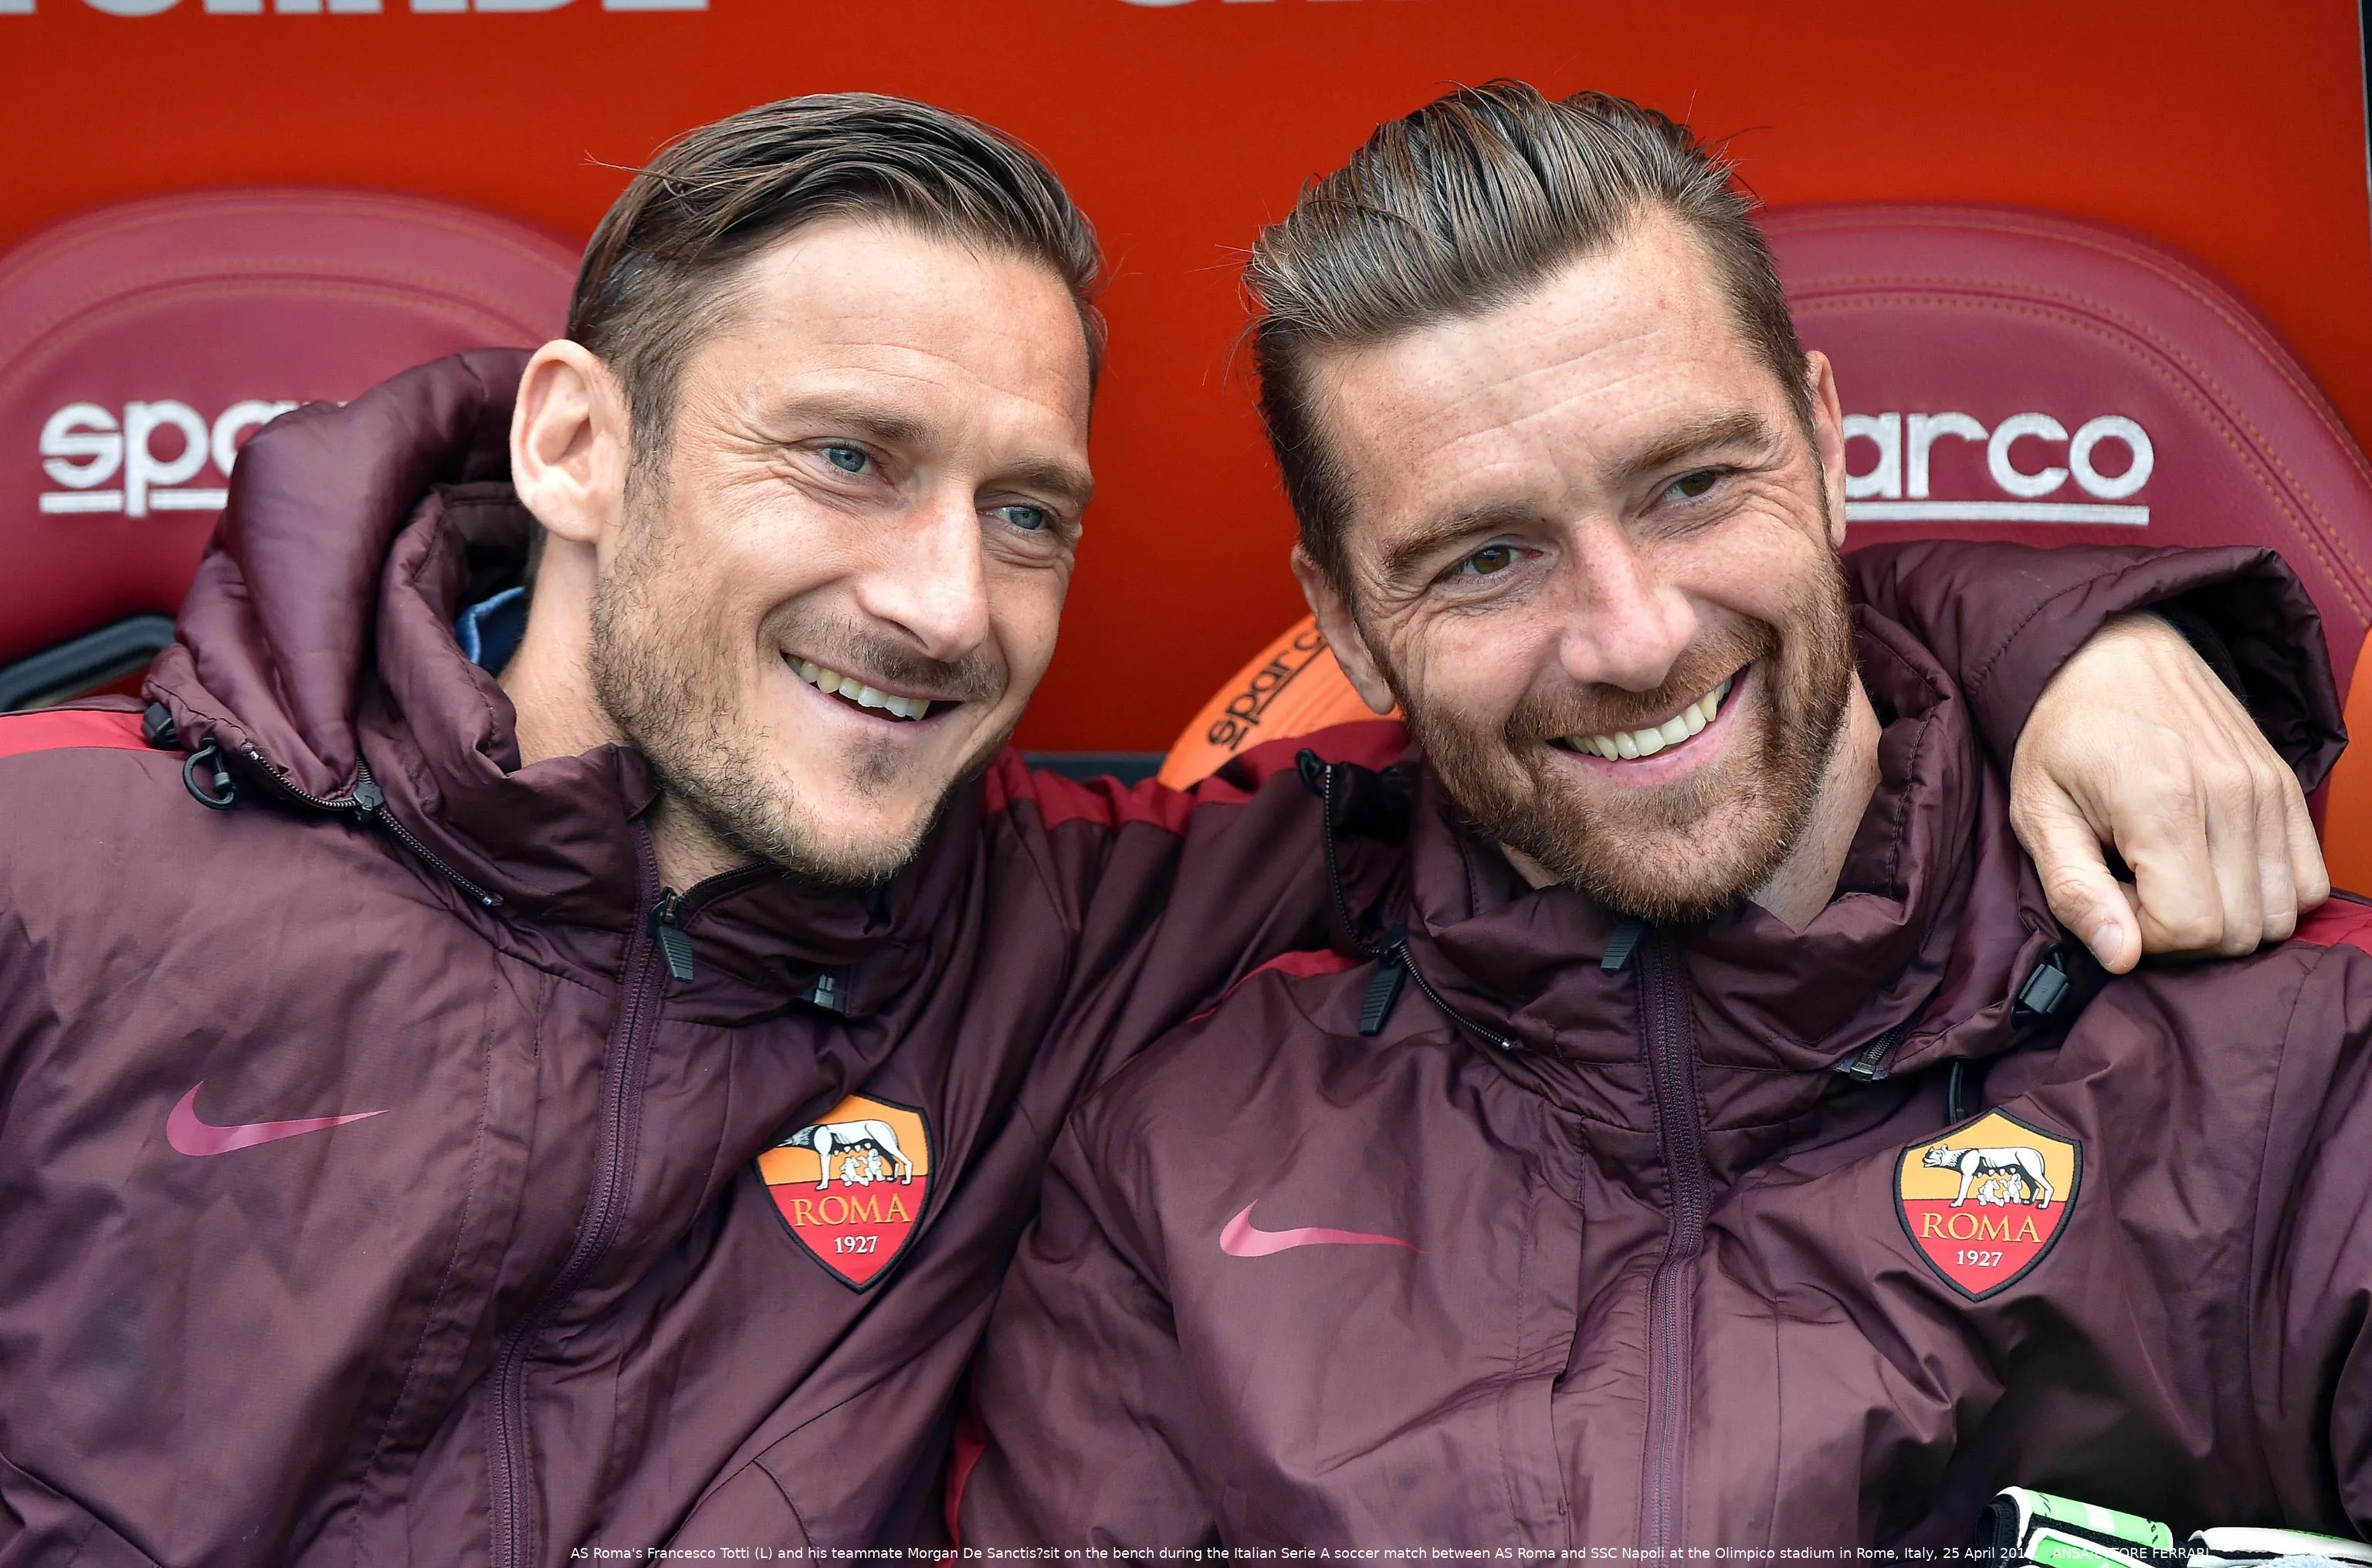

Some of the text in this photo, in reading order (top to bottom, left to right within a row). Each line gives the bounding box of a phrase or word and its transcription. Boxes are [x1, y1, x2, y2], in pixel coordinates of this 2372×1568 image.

[1208, 624, 1323, 747] sparc
[791, 1193, 912, 1227] ROMA
[1920, 1213, 2042, 1244] ROMA
[834, 1236, 878, 1254] 1927
[1957, 1251, 2004, 1267] 1927
